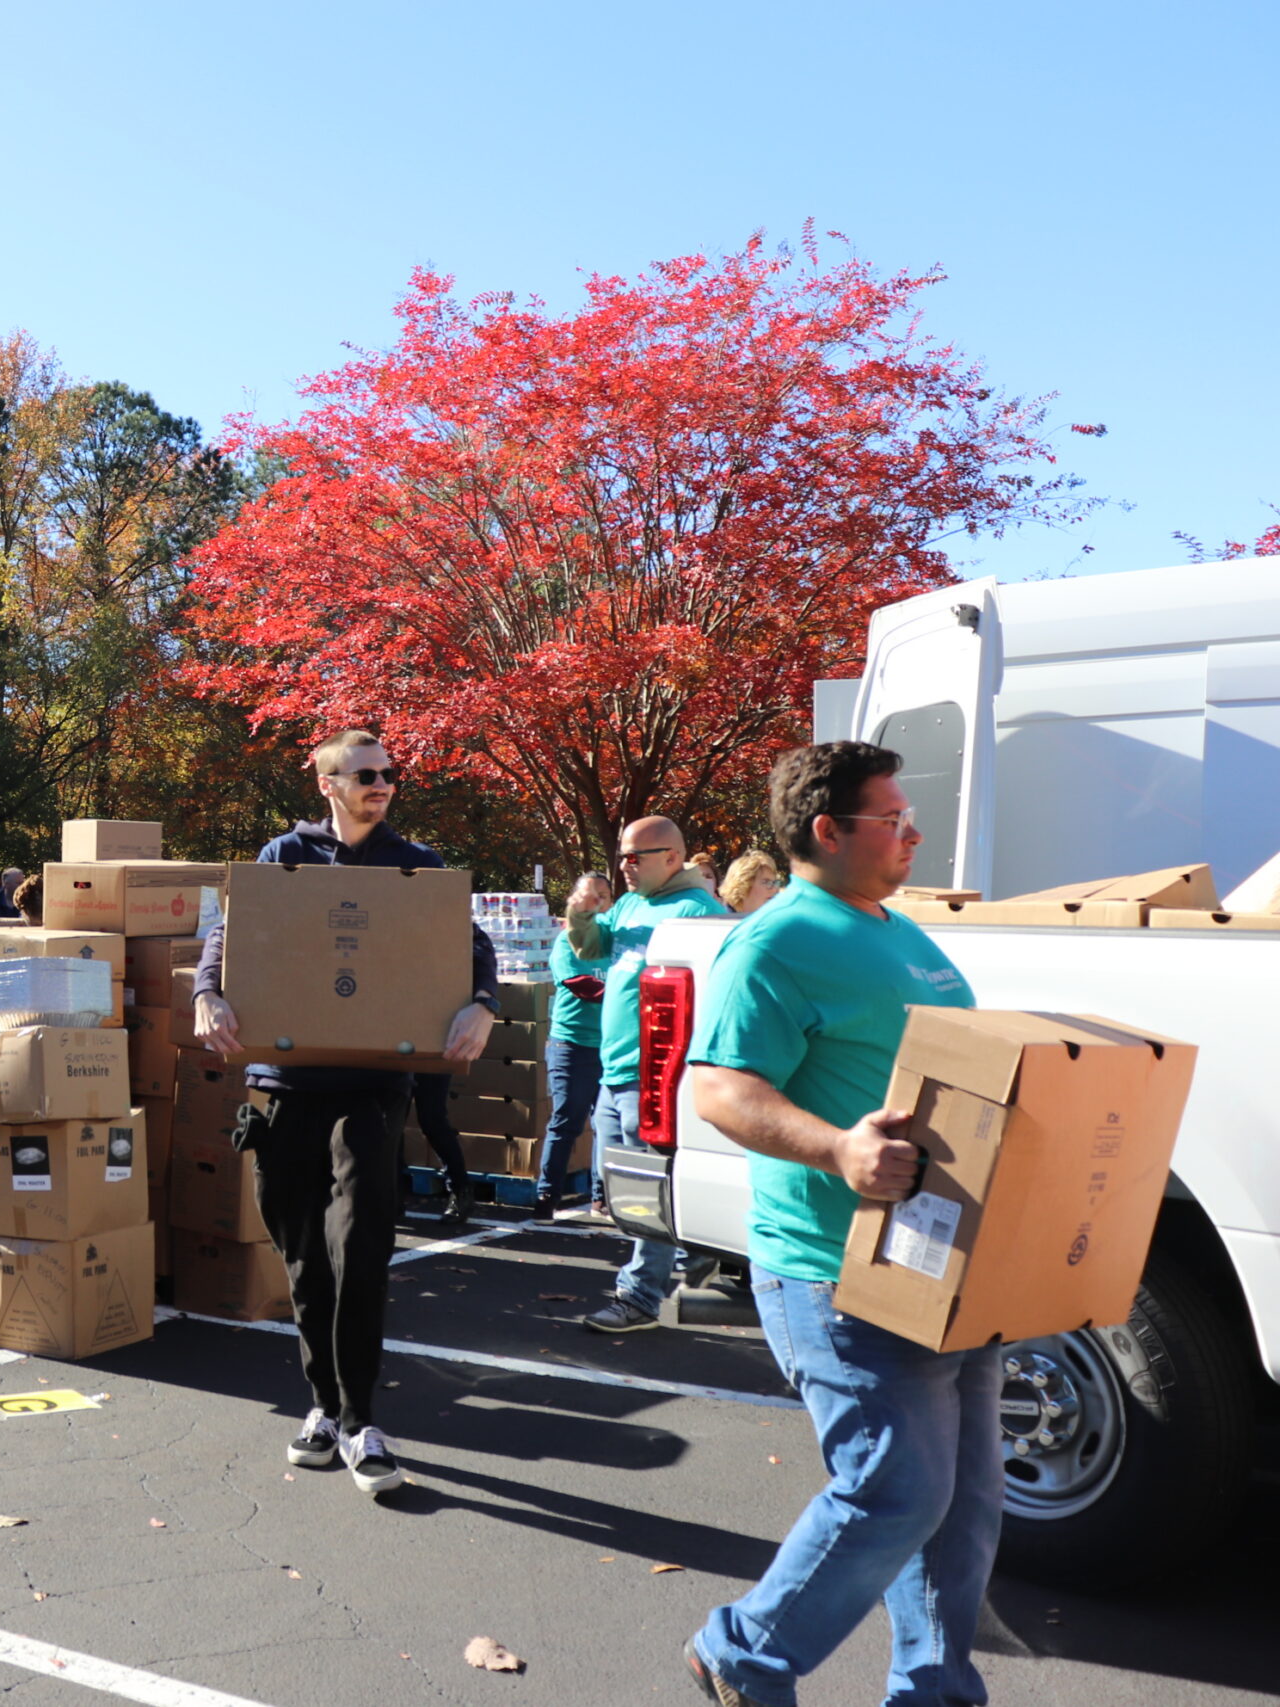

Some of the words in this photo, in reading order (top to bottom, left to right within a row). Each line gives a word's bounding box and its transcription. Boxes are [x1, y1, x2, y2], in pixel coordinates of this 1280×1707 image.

[66, 1064, 110, 1077] Berkshire
[76, 1147, 89, 1158] FOIL
[82, 1267, 93, 1278] FOIL
